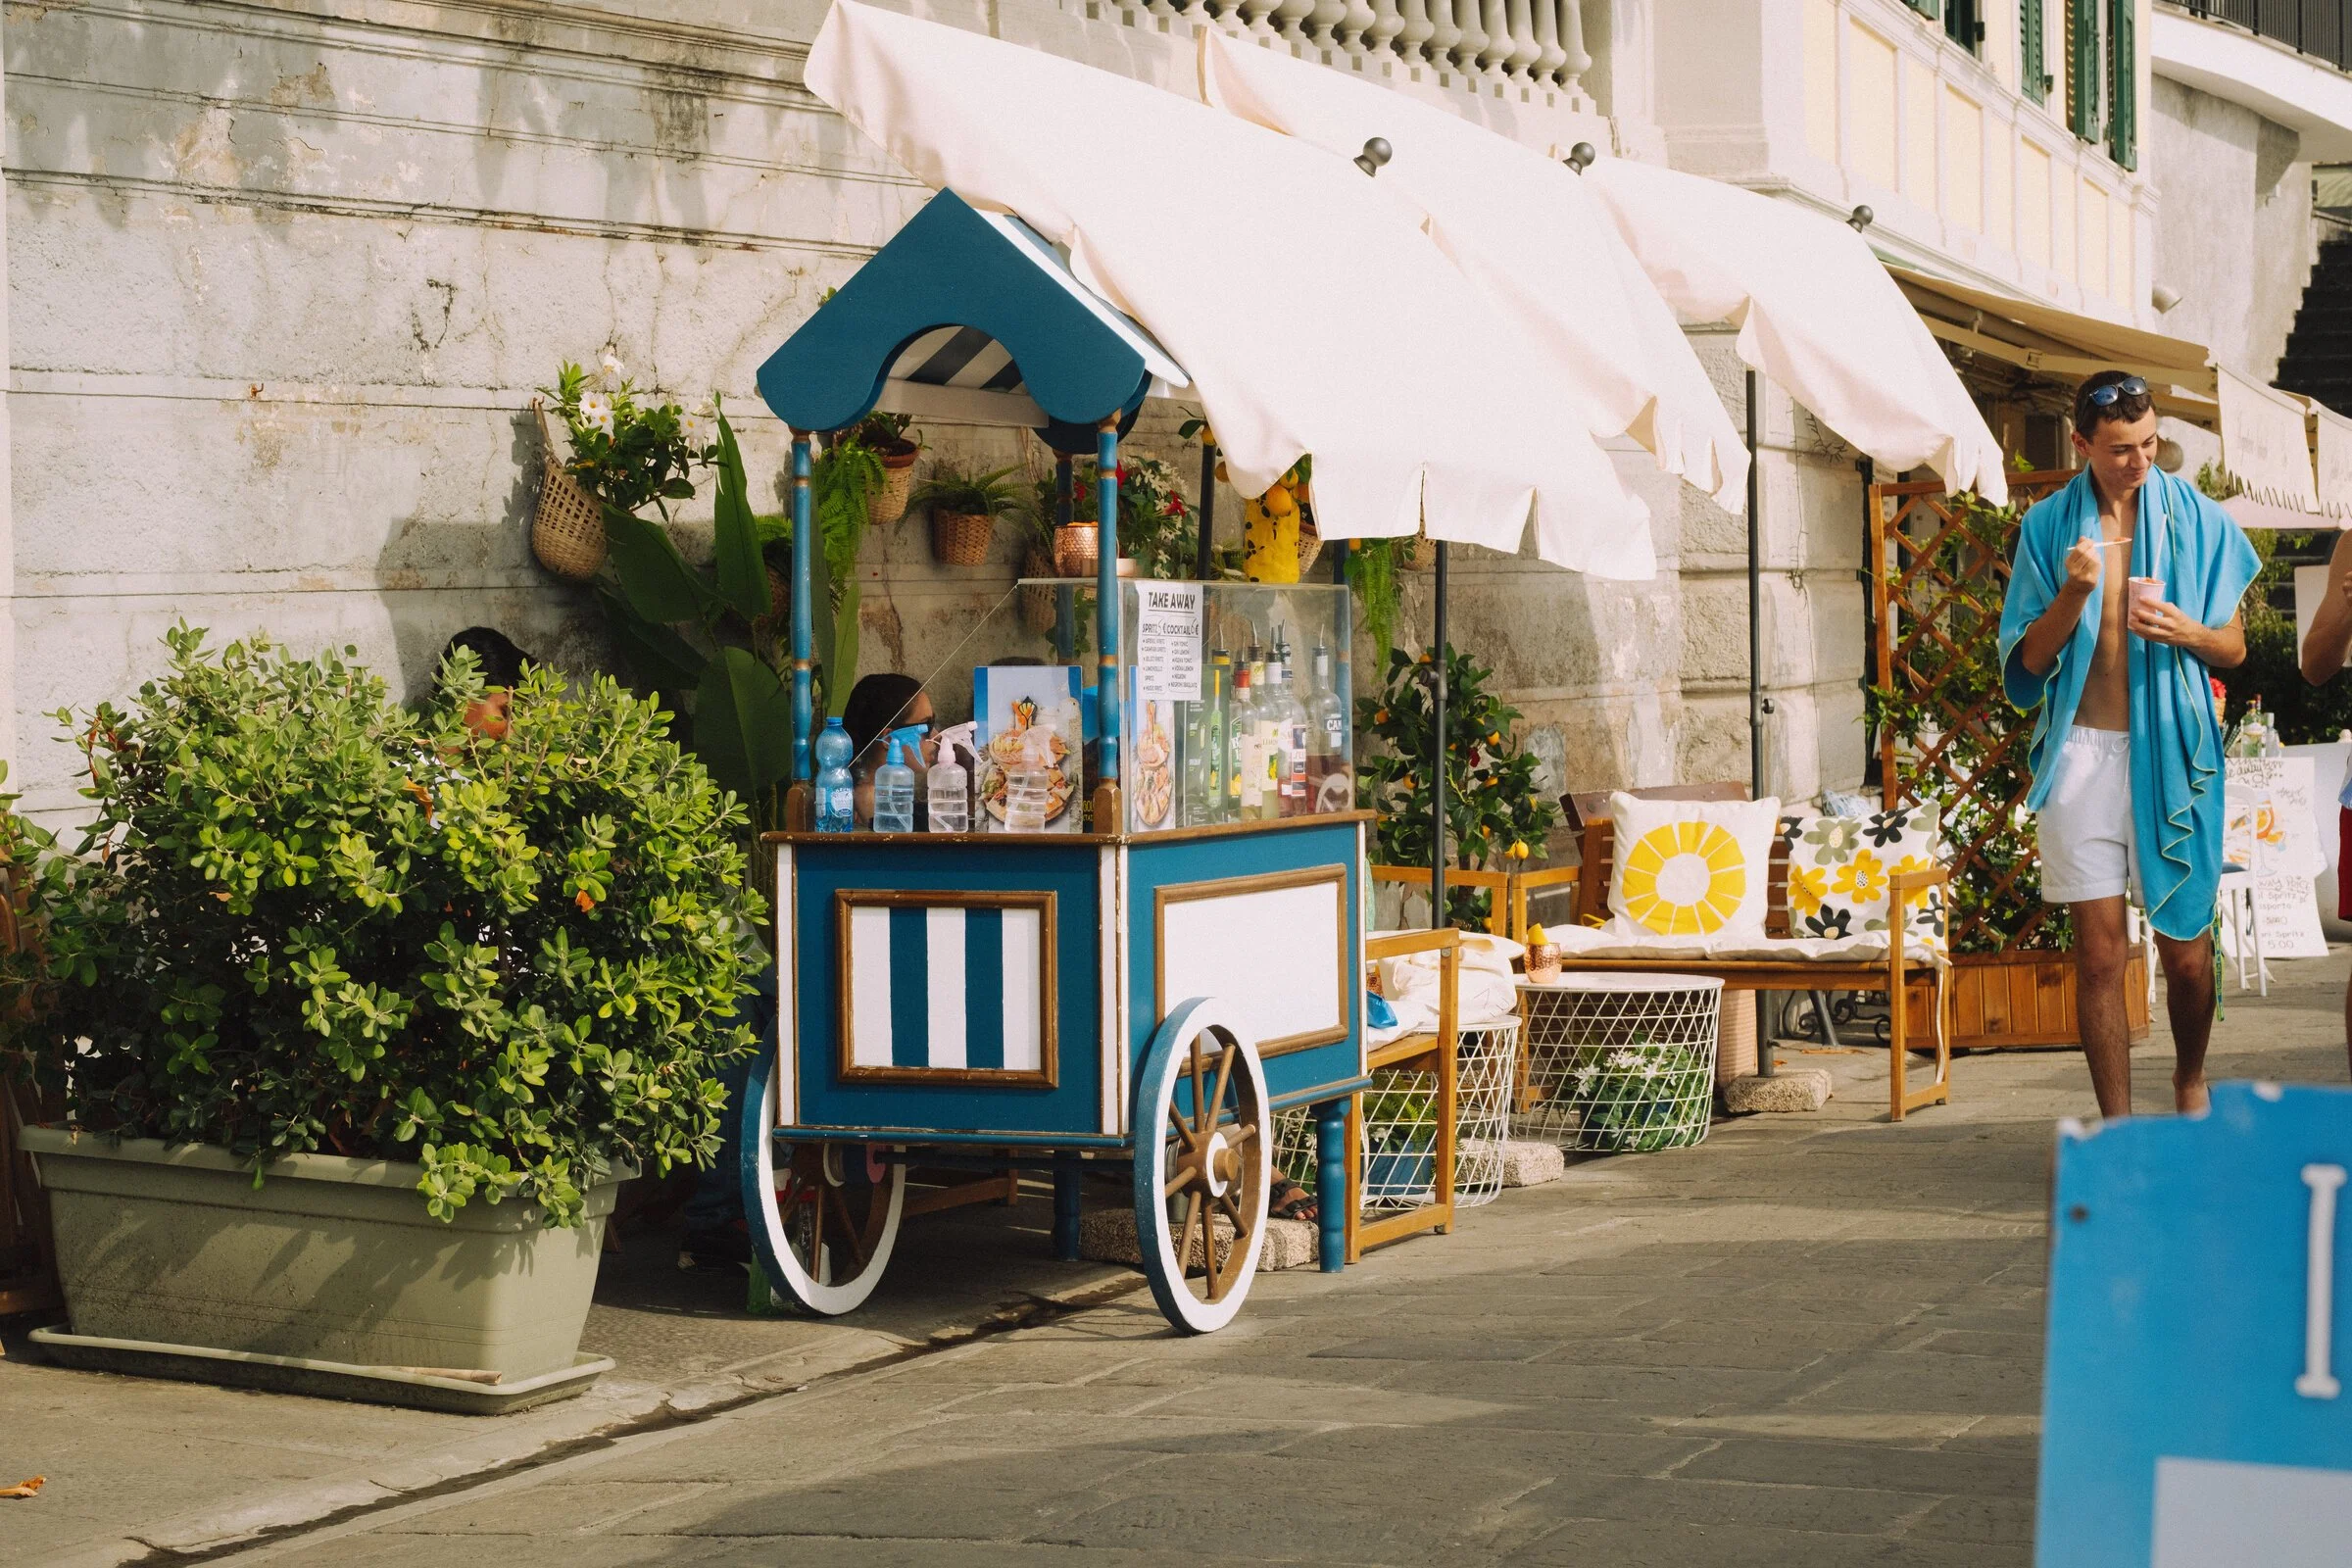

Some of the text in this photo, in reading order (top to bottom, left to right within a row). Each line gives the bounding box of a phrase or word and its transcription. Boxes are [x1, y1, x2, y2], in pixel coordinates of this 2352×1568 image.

[1149, 592, 1196, 610] TAKE AWAY
[1143, 623, 1157, 633] SPRITZ
[1167, 624, 1191, 635] COCKTAIL
